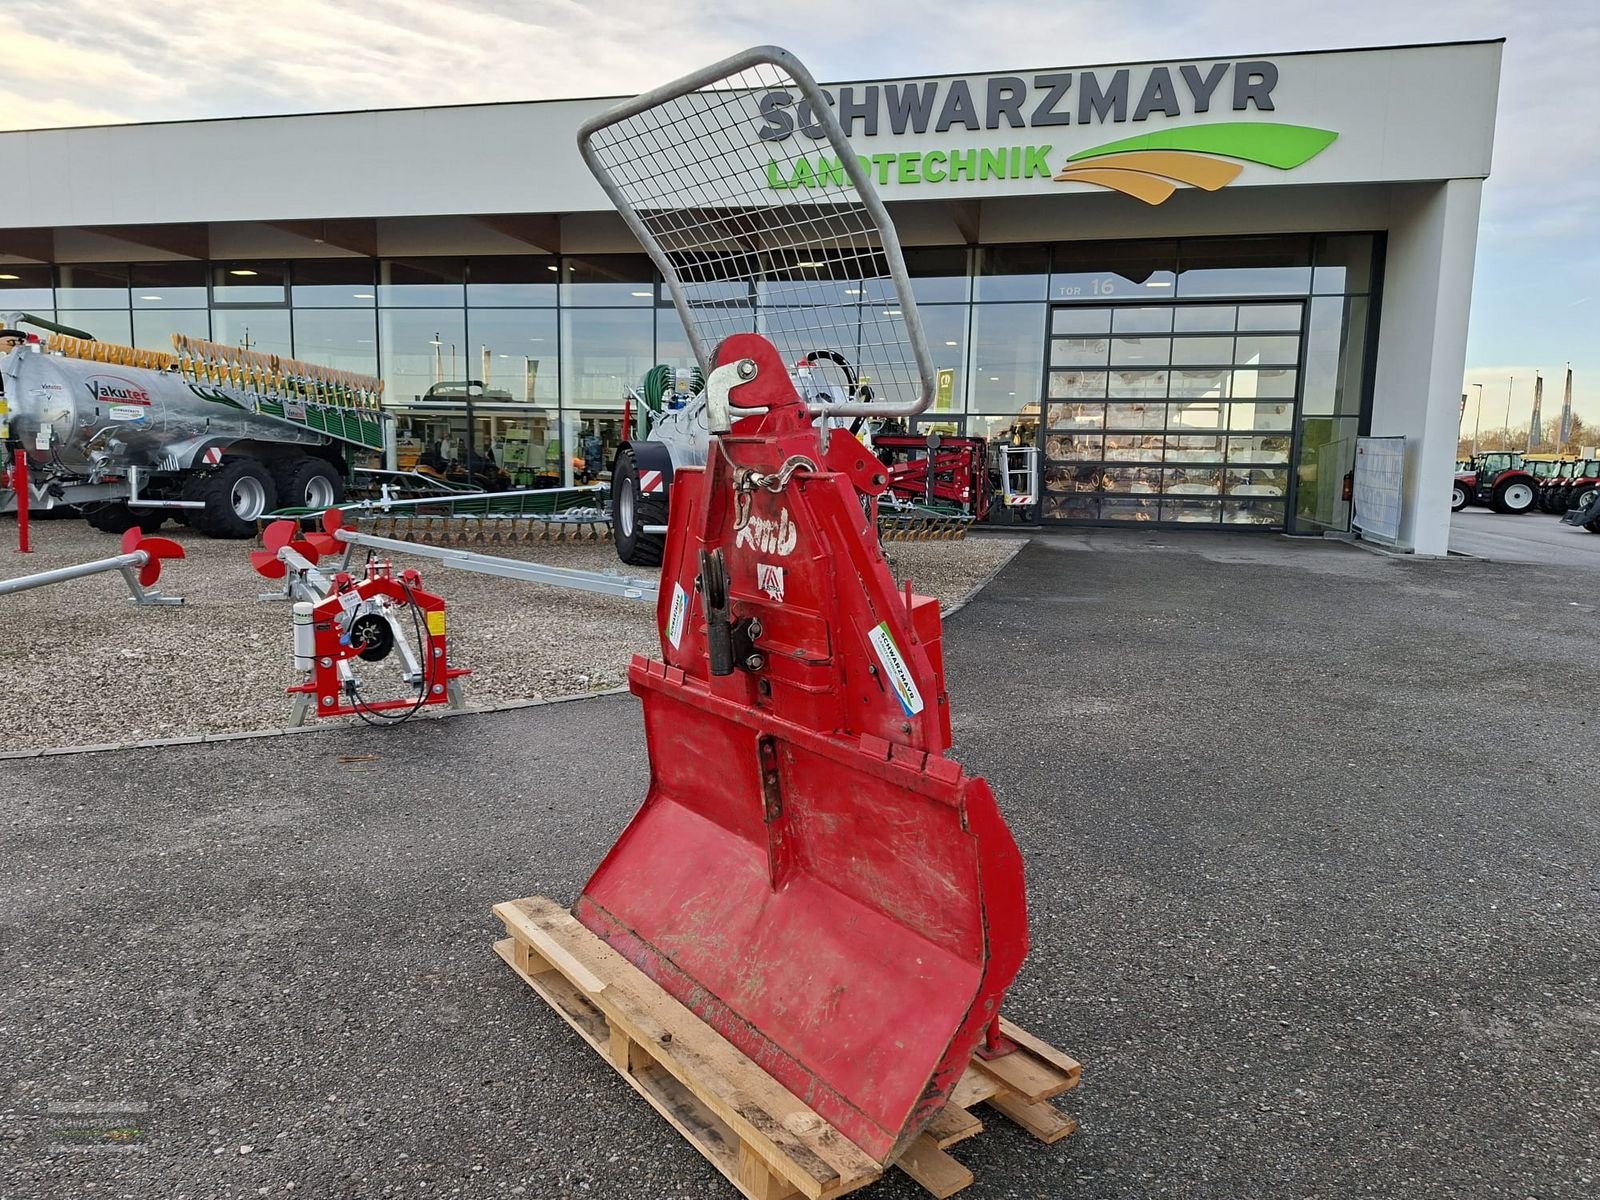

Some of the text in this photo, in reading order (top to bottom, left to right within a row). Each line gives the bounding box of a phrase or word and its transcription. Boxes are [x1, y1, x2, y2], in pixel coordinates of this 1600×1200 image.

[758, 60, 1278, 142] SCHWARZMAYR
[1059, 278, 1114, 296] TOR 16
[85, 380, 150, 401] Vakutec
[880, 632, 914, 699] SCHWARZMAYR
